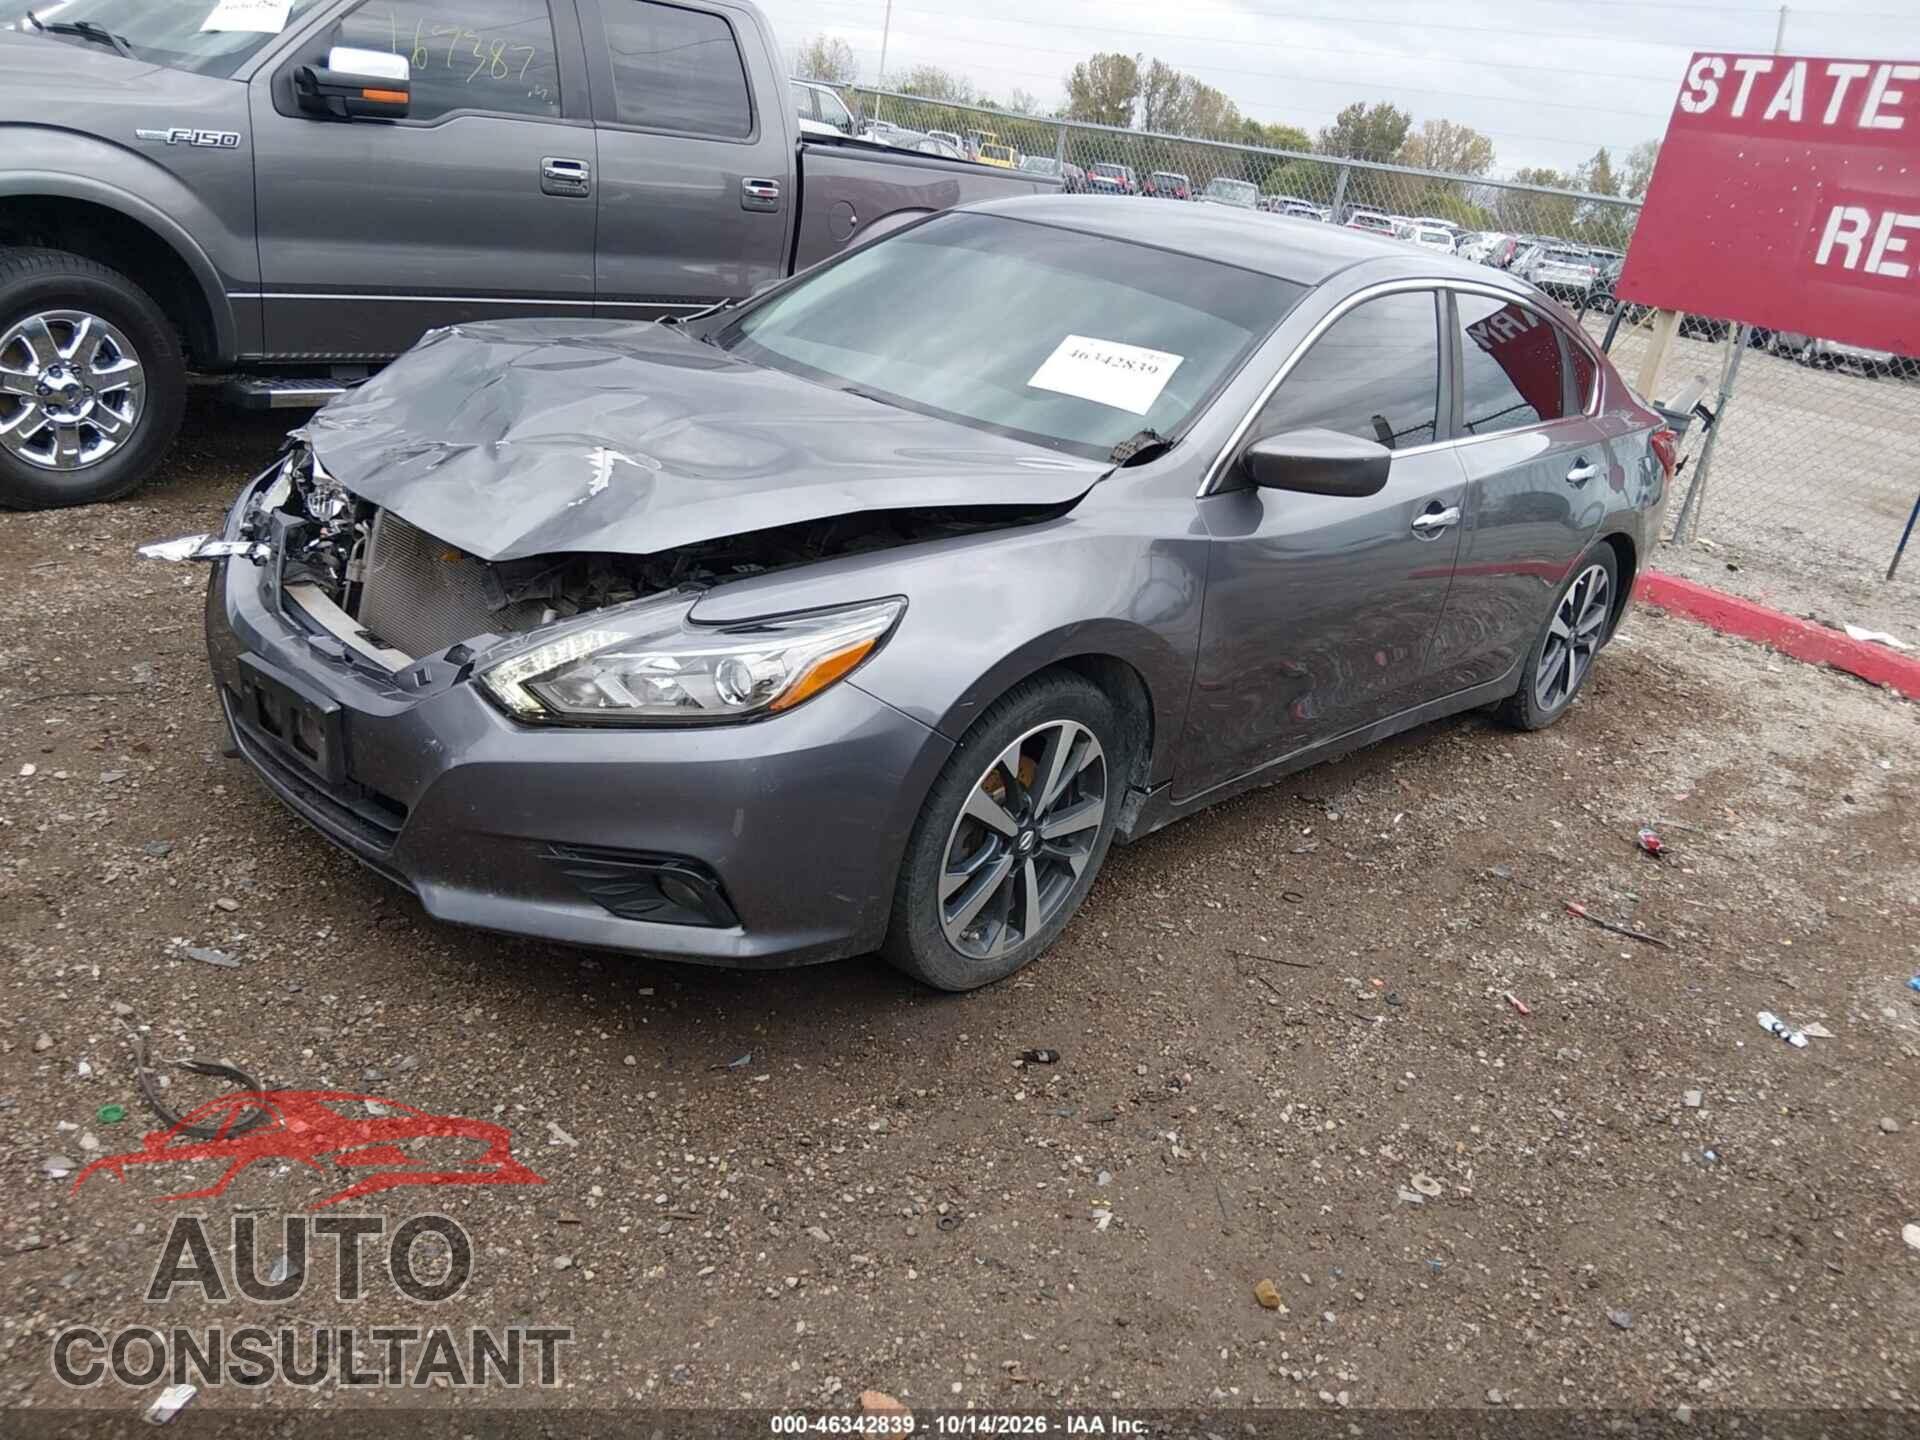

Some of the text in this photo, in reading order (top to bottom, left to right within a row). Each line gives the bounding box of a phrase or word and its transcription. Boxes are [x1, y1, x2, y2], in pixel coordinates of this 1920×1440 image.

[1679, 56, 1920, 129] STATE
[166, 127, 240, 149] F-150
[1815, 206, 1920, 278] RE
